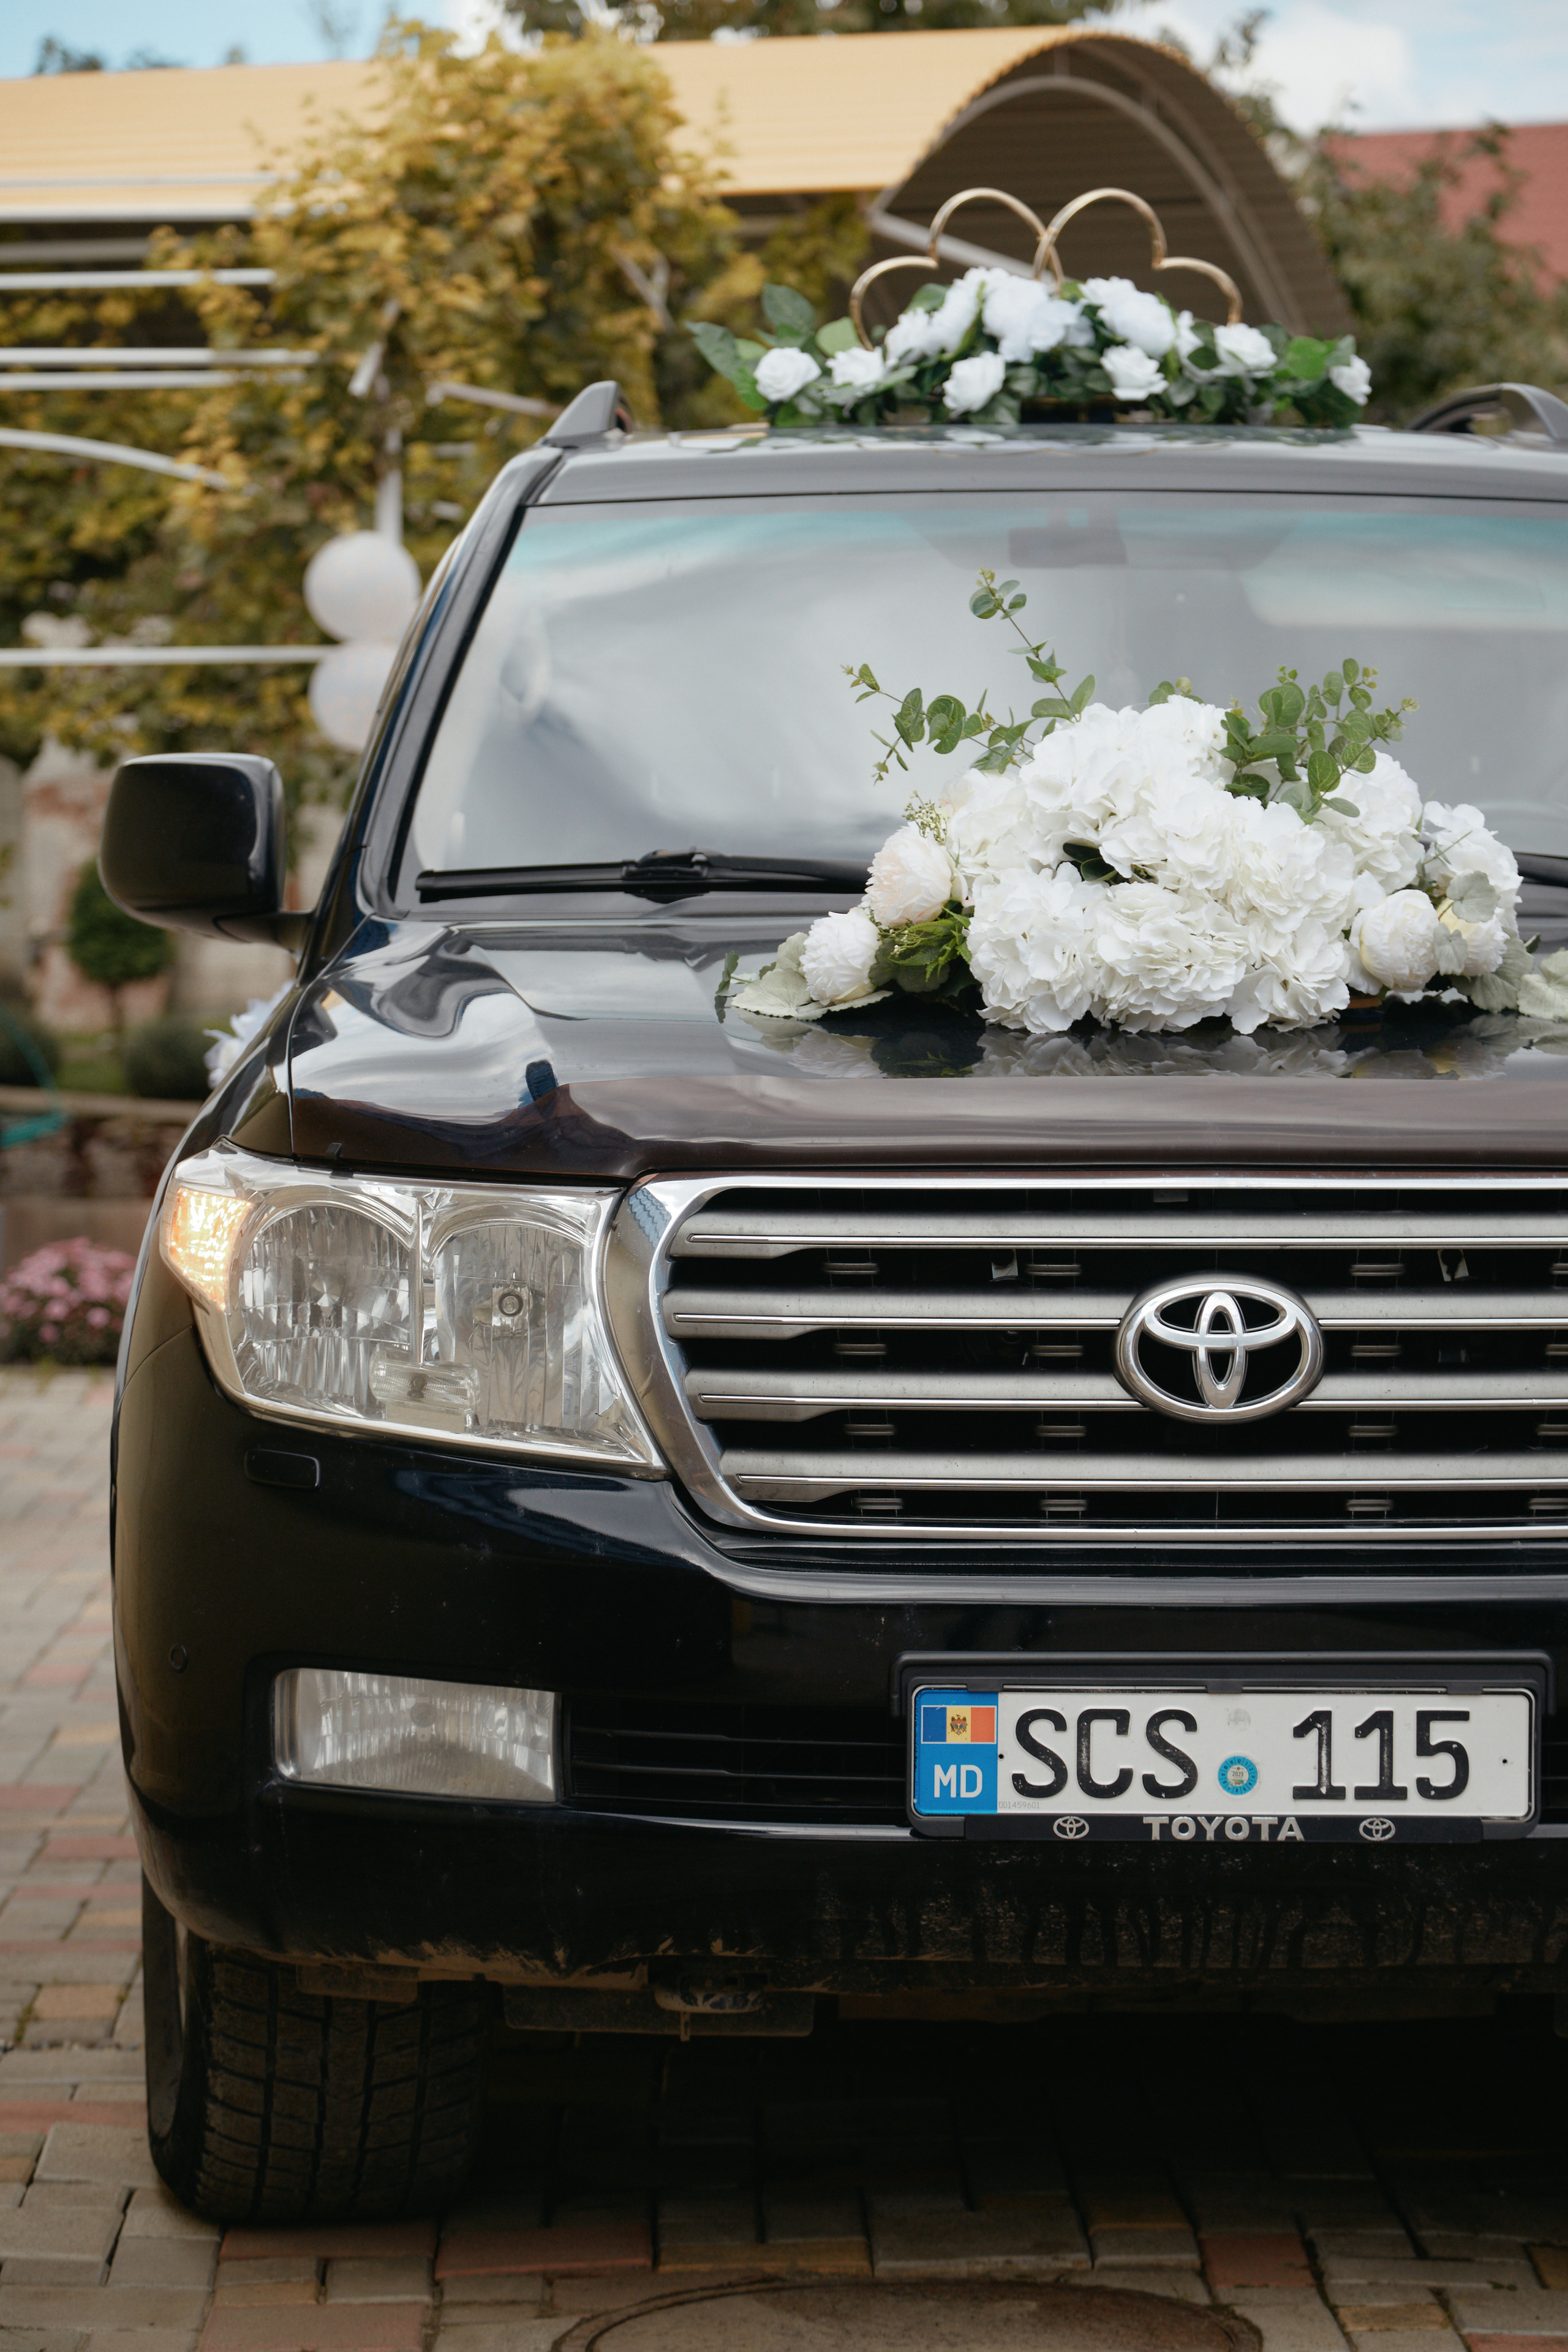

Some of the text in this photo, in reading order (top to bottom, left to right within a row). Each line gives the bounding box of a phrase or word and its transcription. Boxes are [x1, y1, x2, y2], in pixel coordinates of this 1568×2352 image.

[1012, 1709, 1471, 1800] SCS 115
[935, 1765, 983, 1798] MD
[1143, 1817, 1305, 1841] TOYOTA
